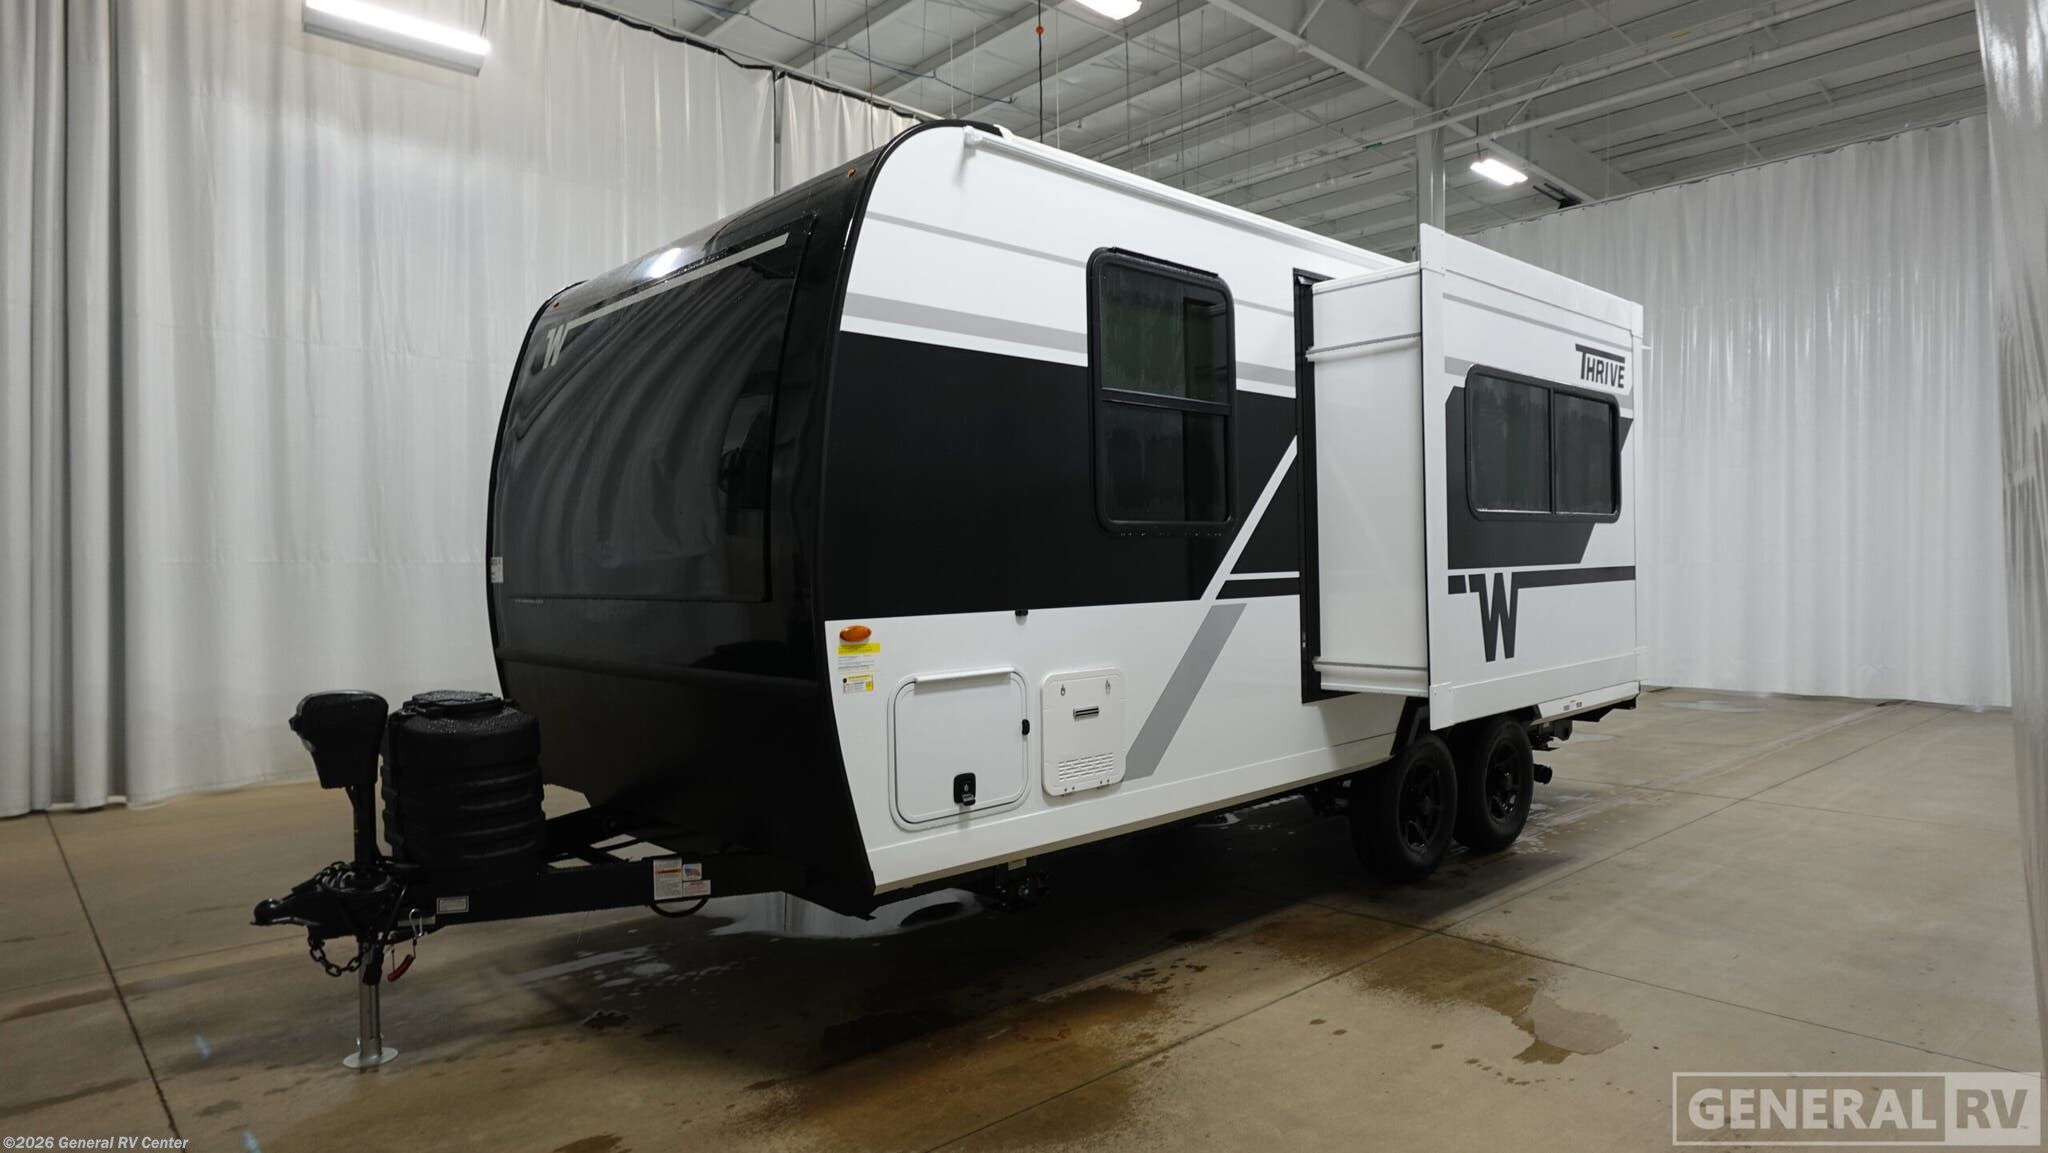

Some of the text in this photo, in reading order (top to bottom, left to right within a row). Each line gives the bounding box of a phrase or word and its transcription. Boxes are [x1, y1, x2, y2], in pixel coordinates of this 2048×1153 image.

[543, 323, 570, 370] W
[1575, 343, 1626, 389] THRIVE
[1468, 572, 1520, 663] W
